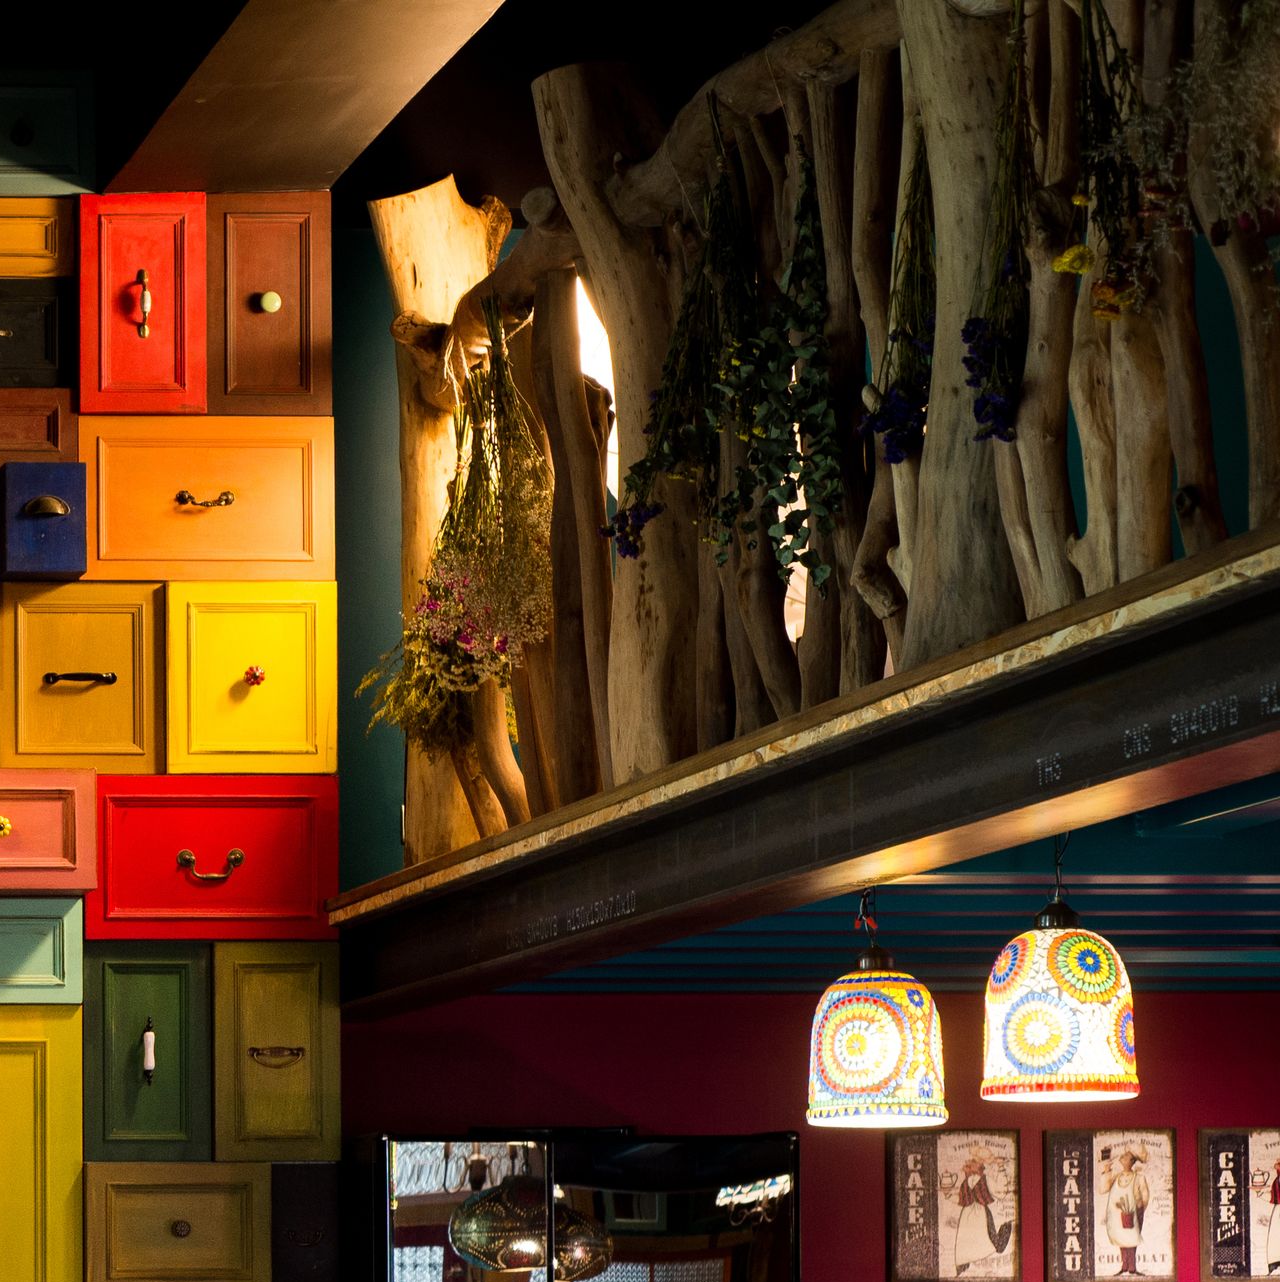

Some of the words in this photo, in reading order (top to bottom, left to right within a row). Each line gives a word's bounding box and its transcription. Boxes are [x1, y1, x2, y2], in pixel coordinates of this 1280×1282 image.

[984, 1139, 1007, 1150] Roast
[1063, 1149, 1080, 1159] Le
[1141, 1138, 1163, 1149] Roast
[905, 1153, 924, 1224] CAFE
[1217, 1152, 1237, 1223] CAFE
[1062, 1159, 1082, 1272] GATEAU
